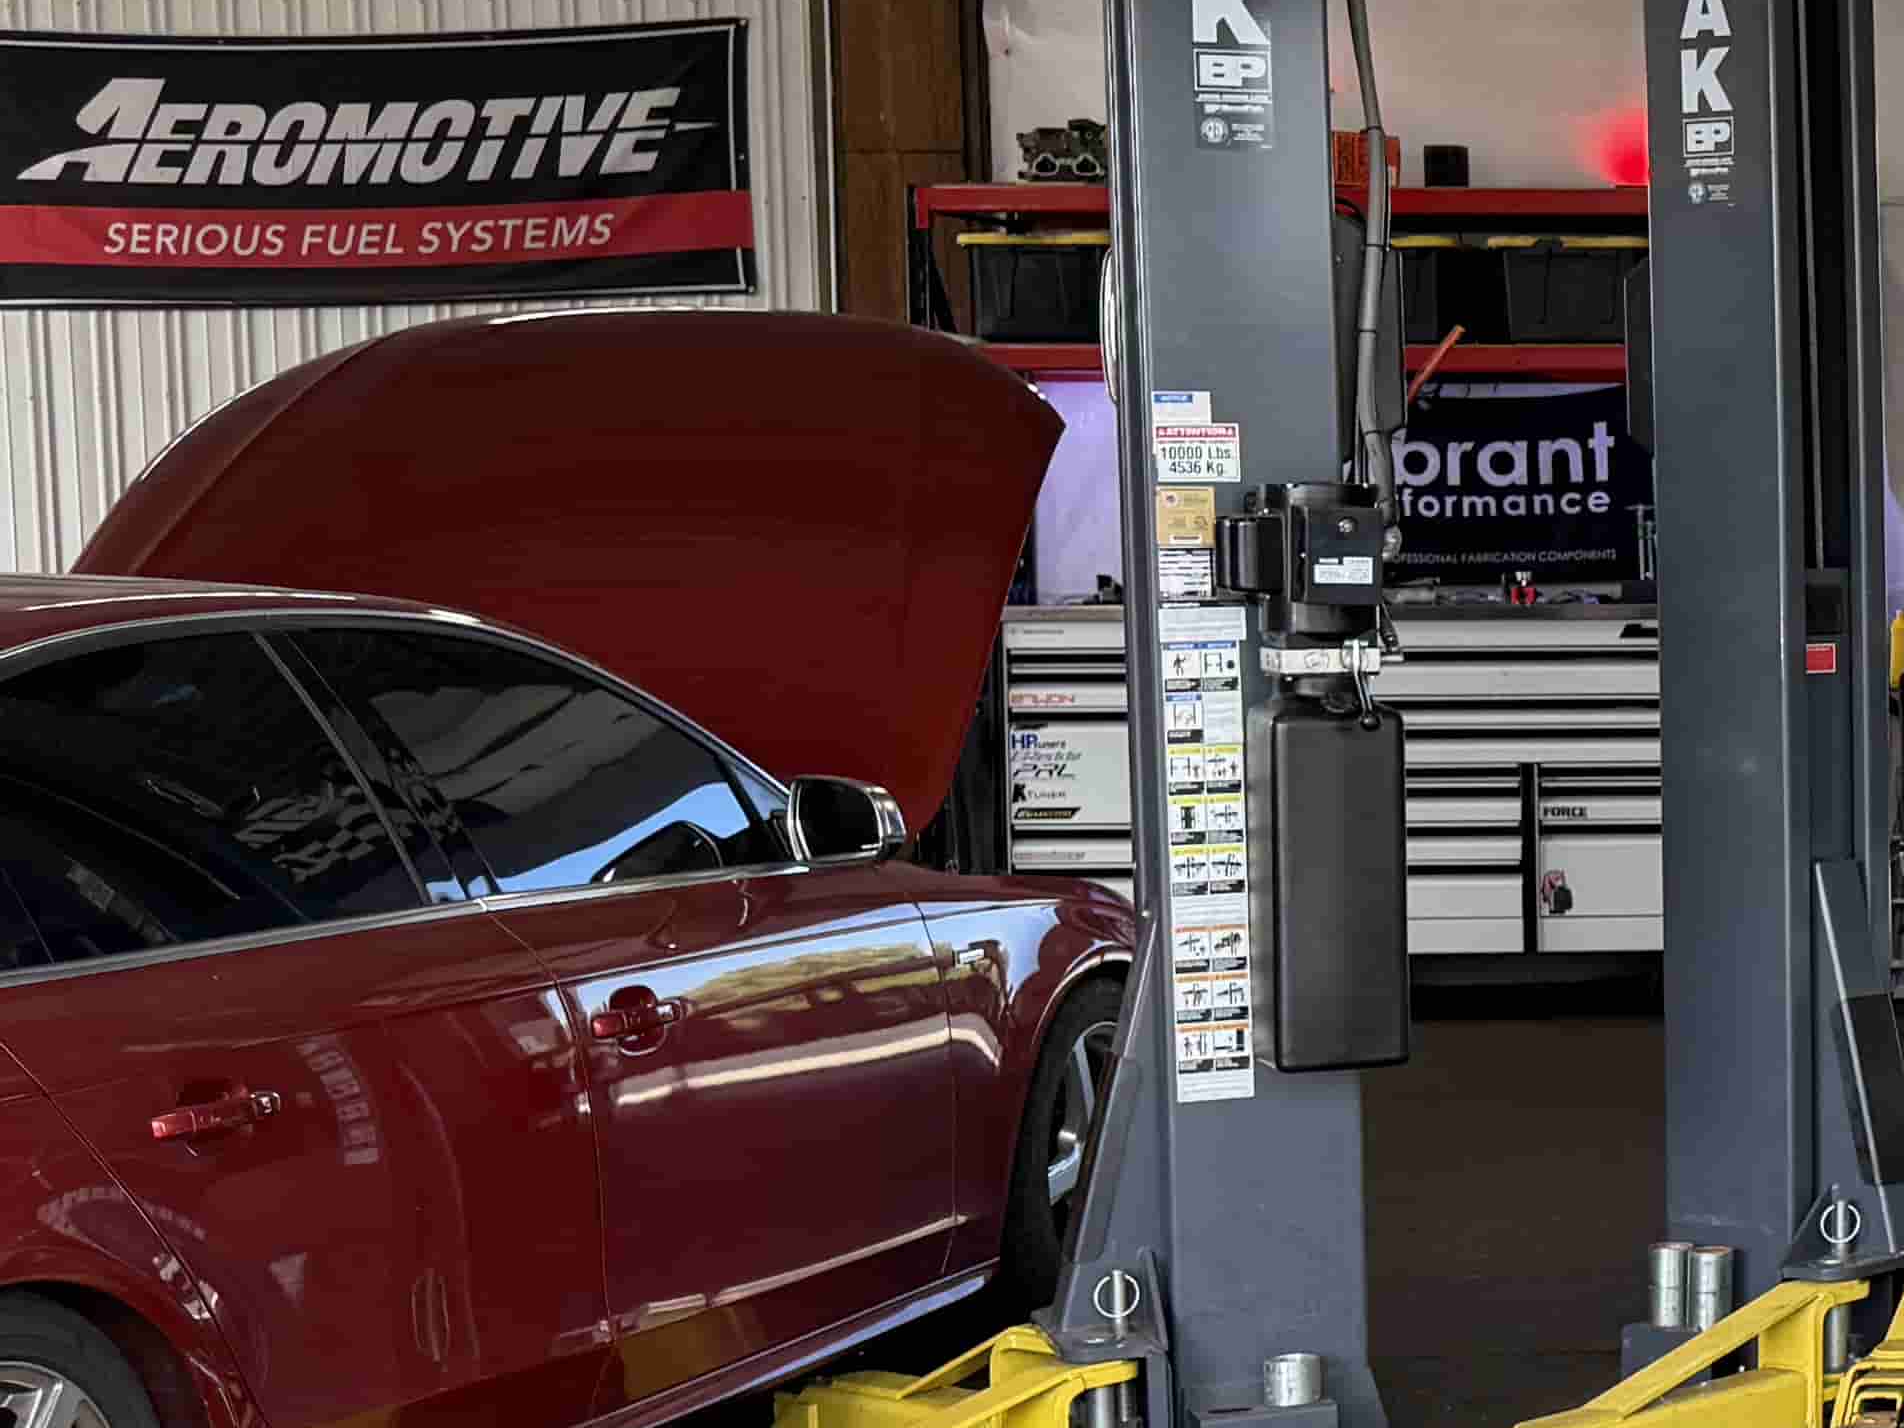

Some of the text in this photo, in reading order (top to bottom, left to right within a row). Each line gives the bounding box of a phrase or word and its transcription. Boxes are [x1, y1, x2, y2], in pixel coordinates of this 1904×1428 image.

[16, 76, 680, 186] AEROMOTIVE
[103, 212, 615, 257] SERIOUS FUEL SYSTEMS
[1160, 445, 1203, 460] 10000
[1168, 460, 1202, 474] 4536
[1391, 421, 1615, 487] brant
[1543, 806, 1588, 819] FORCE
